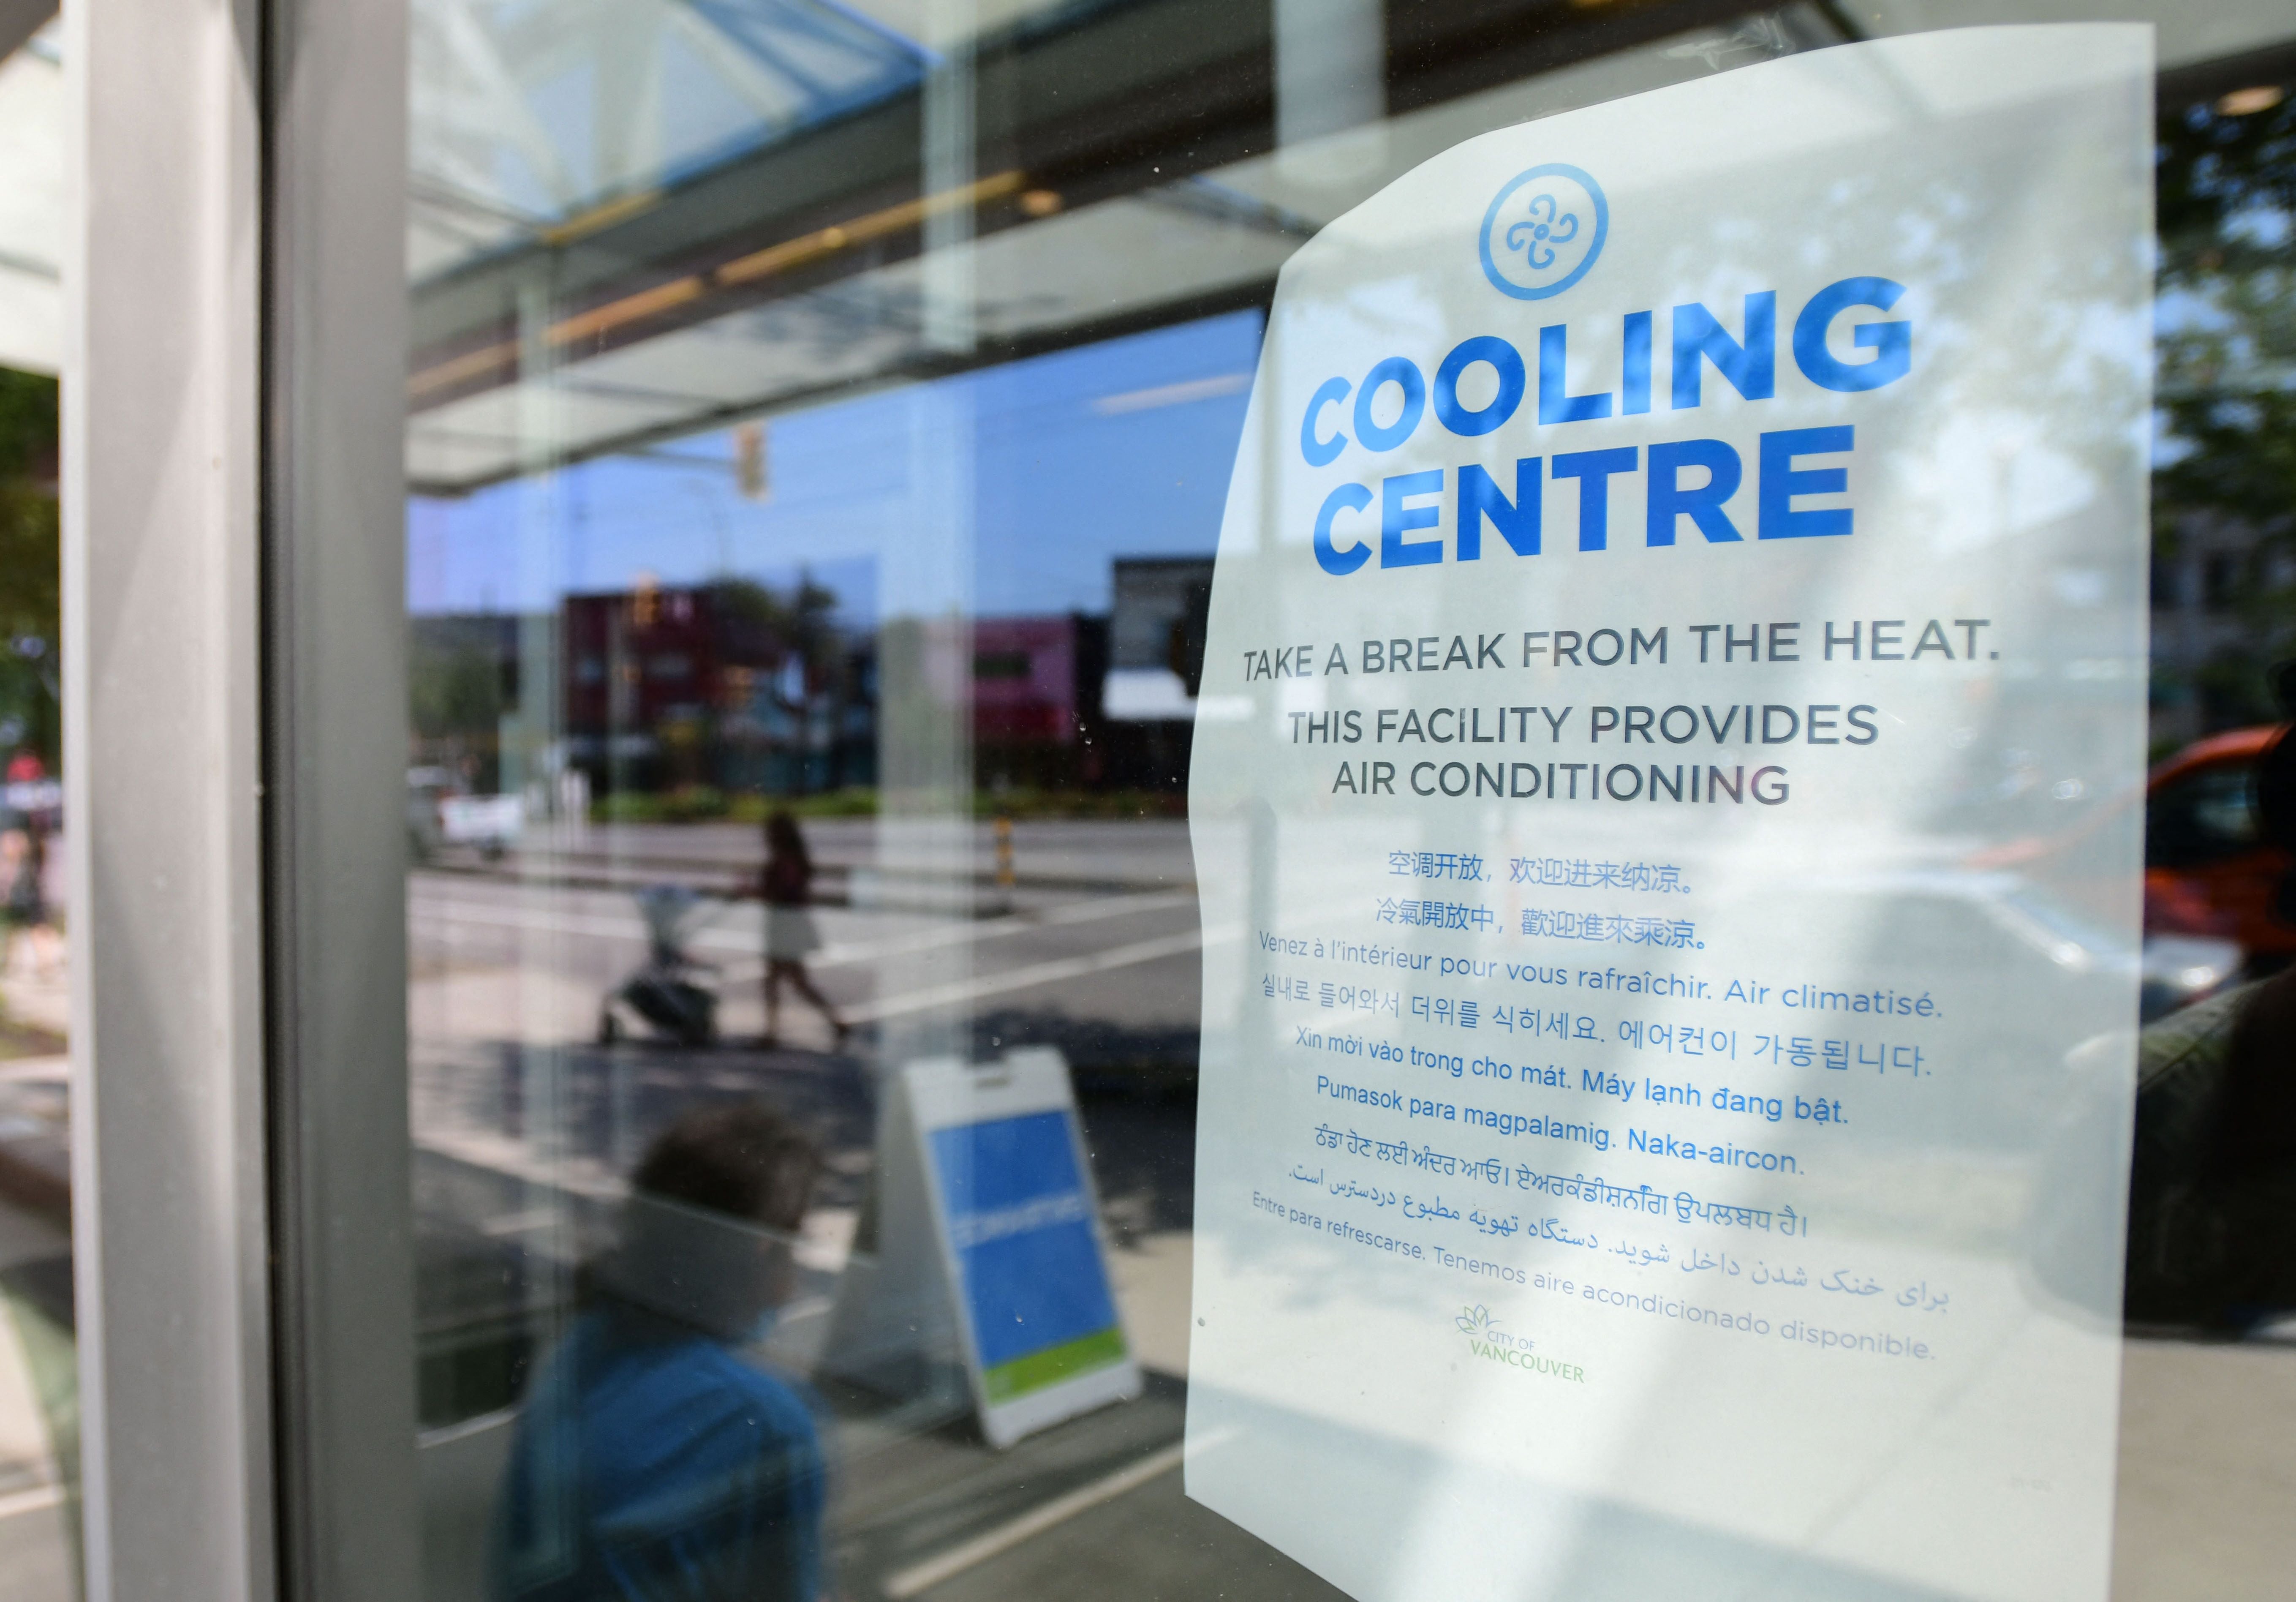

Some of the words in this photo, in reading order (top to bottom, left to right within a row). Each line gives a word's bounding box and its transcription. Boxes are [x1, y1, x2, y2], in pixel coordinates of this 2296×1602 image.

[1301, 276, 1912, 467] COOLING
[1313, 424, 1855, 576] CENTRE
[1244, 645, 1314, 681] TAKE
[1324, 643, 1349, 676] A
[1363, 633, 1506, 673] BREAK
[1523, 627, 1668, 667] FROM
[1689, 622, 1801, 662] THE
[1825, 619, 1999, 661] HEAT.
[1288, 710, 1362, 744] THIS
[1377, 706, 1573, 743] FACILITY
[1592, 705, 1879, 745] PROVIDES
[1332, 761, 1395, 795] AIR
[1411, 761, 1790, 806] CONDITIONING
[1259, 930, 1308, 956] Venez
[1314, 939, 1324, 958] à
[1440, 956, 1497, 978] pour
[1507, 964, 1567, 985] vous
[1578, 968, 1712, 1000] rafraîchir.
[1725, 979, 1770, 1004] Air
[1782, 984, 1942, 1018] climatisé.
[1262, 973, 1311, 1002] 실내로
[1318, 981, 1400, 1018] 들어와서
[1412, 995, 1480, 1029] 더위를
[1492, 1005, 1605, 1043] 식히세요.
[1619, 1019, 1737, 1060] 에어컨이
[1754, 1034, 1932, 1077] 가동됩니다.
[1296, 1025, 1322, 1049] Xin
[1328, 1034, 1363, 1056] mời
[1369, 1039, 1403, 1063] vào
[1411, 1046, 1464, 1078] trong
[1472, 1055, 1512, 1080] cho
[1521, 1065, 1572, 1089] mát.
[1582, 1069, 1636, 1102] Máy
[1645, 1078, 1701, 1106] lạnh
[1712, 1086, 1783, 1122] đang
[1795, 1095, 1848, 1125] bật.
[1317, 1075, 1403, 1112] Pumasok
[1409, 1096, 1456, 1122] para
[1464, 1106, 1616, 1152] magpalamig.
[1628, 1128, 1805, 1175] Naka-aircon.
[1403, 1196, 1460, 1221] مطبوع
[1469, 1209, 1518, 1237] تهویه
[1528, 1218, 1599, 1249] دستگاه
[1253, 1191, 1285, 1217] Entre
[1289, 1207, 1322, 1230] para
[1327, 1219, 1426, 1261] refrescarse.
[1434, 1246, 1526, 1285] Tenemos
[1534, 1272, 1575, 1295] aire
[1583, 1285, 1771, 1335] acondicionado
[1781, 1320, 1936, 1360] disponible.
[1681, 1248, 1741, 1276] داخل
[1752, 1260, 1808, 1287] شدن
[1820, 1270, 1884, 1296] خنک
[1896, 1282, 1949, 1313] برای
[1470, 1339, 1584, 1383] VANCOUVER
[1488, 1331, 1515, 1346] CITY
[1519, 1338, 1535, 1351] OF
